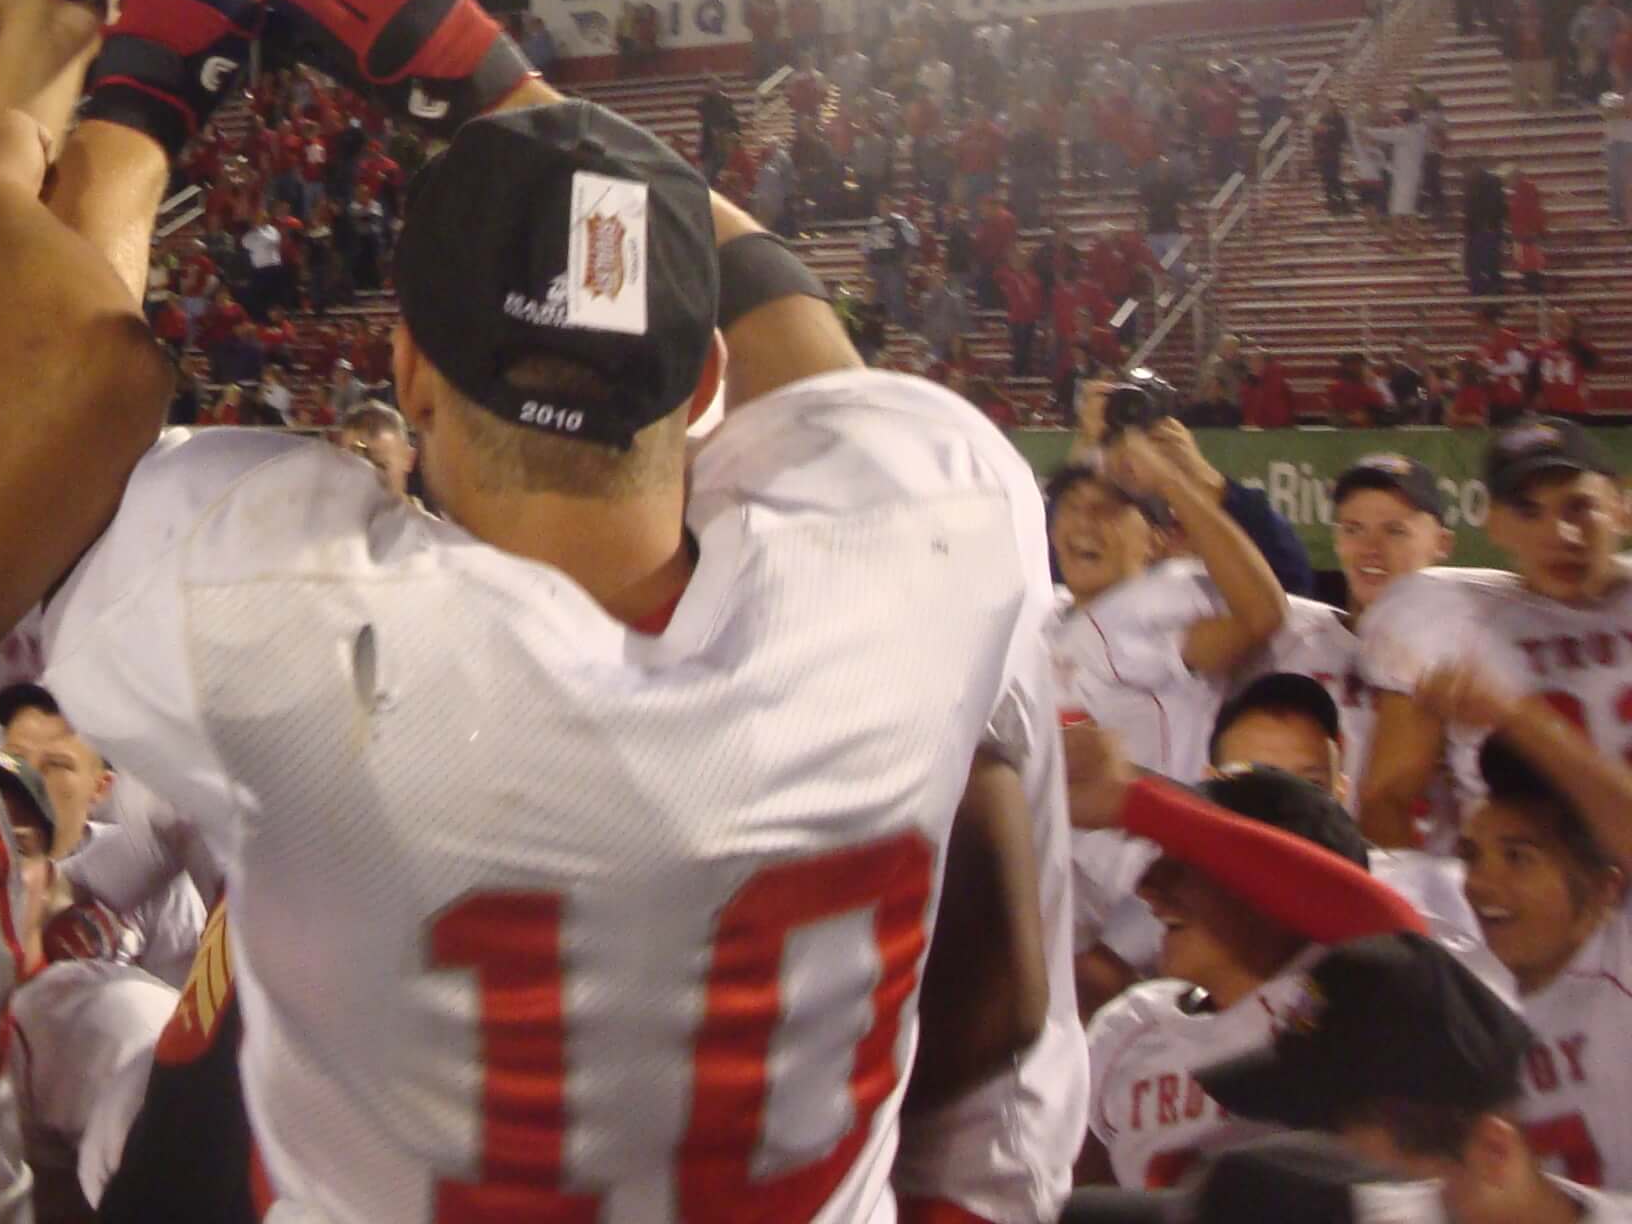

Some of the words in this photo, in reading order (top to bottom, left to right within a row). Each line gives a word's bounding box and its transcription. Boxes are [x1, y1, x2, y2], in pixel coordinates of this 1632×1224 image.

[519, 400, 584, 432] 2010
[1515, 631, 1632, 674] TRO
[421, 826, 939, 1224] 10
[1131, 1073, 1229, 1129] TRO
